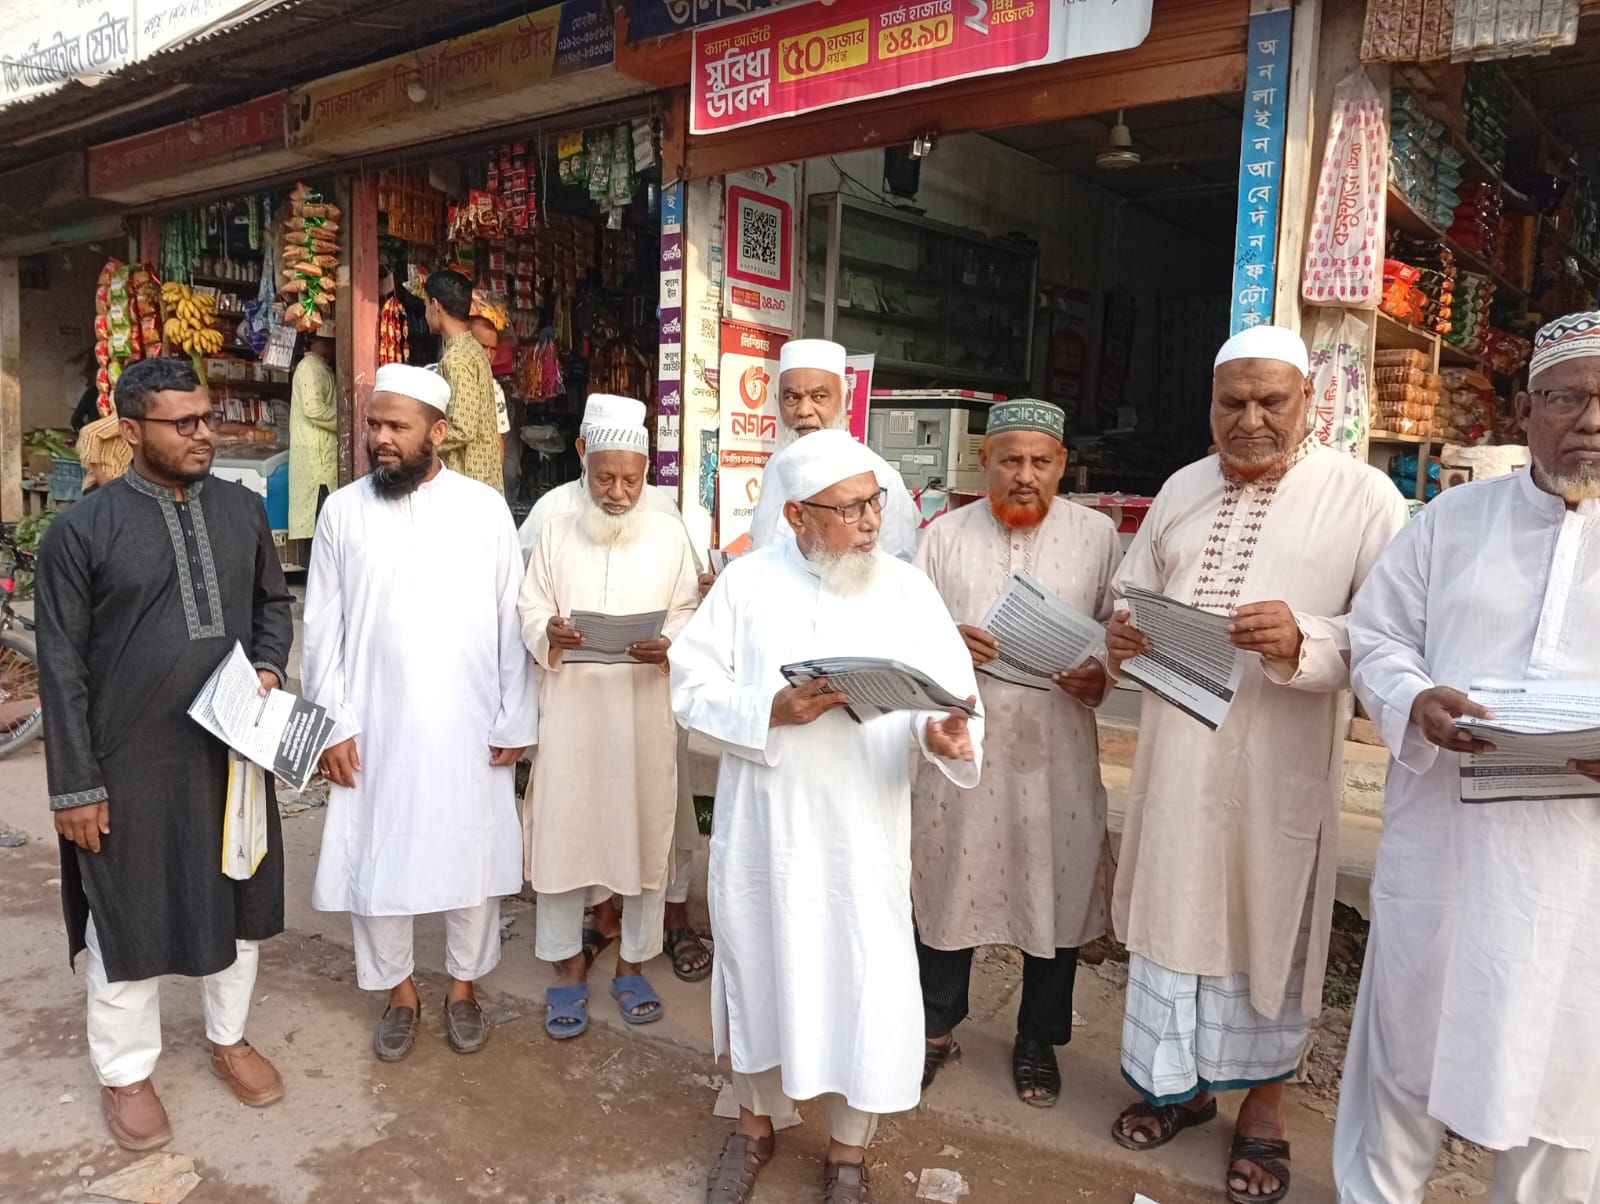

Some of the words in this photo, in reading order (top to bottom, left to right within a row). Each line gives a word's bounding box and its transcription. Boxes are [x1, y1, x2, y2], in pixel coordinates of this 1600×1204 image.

[880, 9, 906, 28] চার্জ
[909, 1, 952, 21] হাজারে
[704, 39, 730, 56] ক্যাশ
[733, 24, 770, 48] আউটে
[828, 28, 865, 51] হাজার
[705, 47, 770, 92] সুবিধা
[826, 51, 848, 65] পর্যন্ত
[706, 78, 770, 118] ডাবল
[731, 412, 776, 438] নগদ
